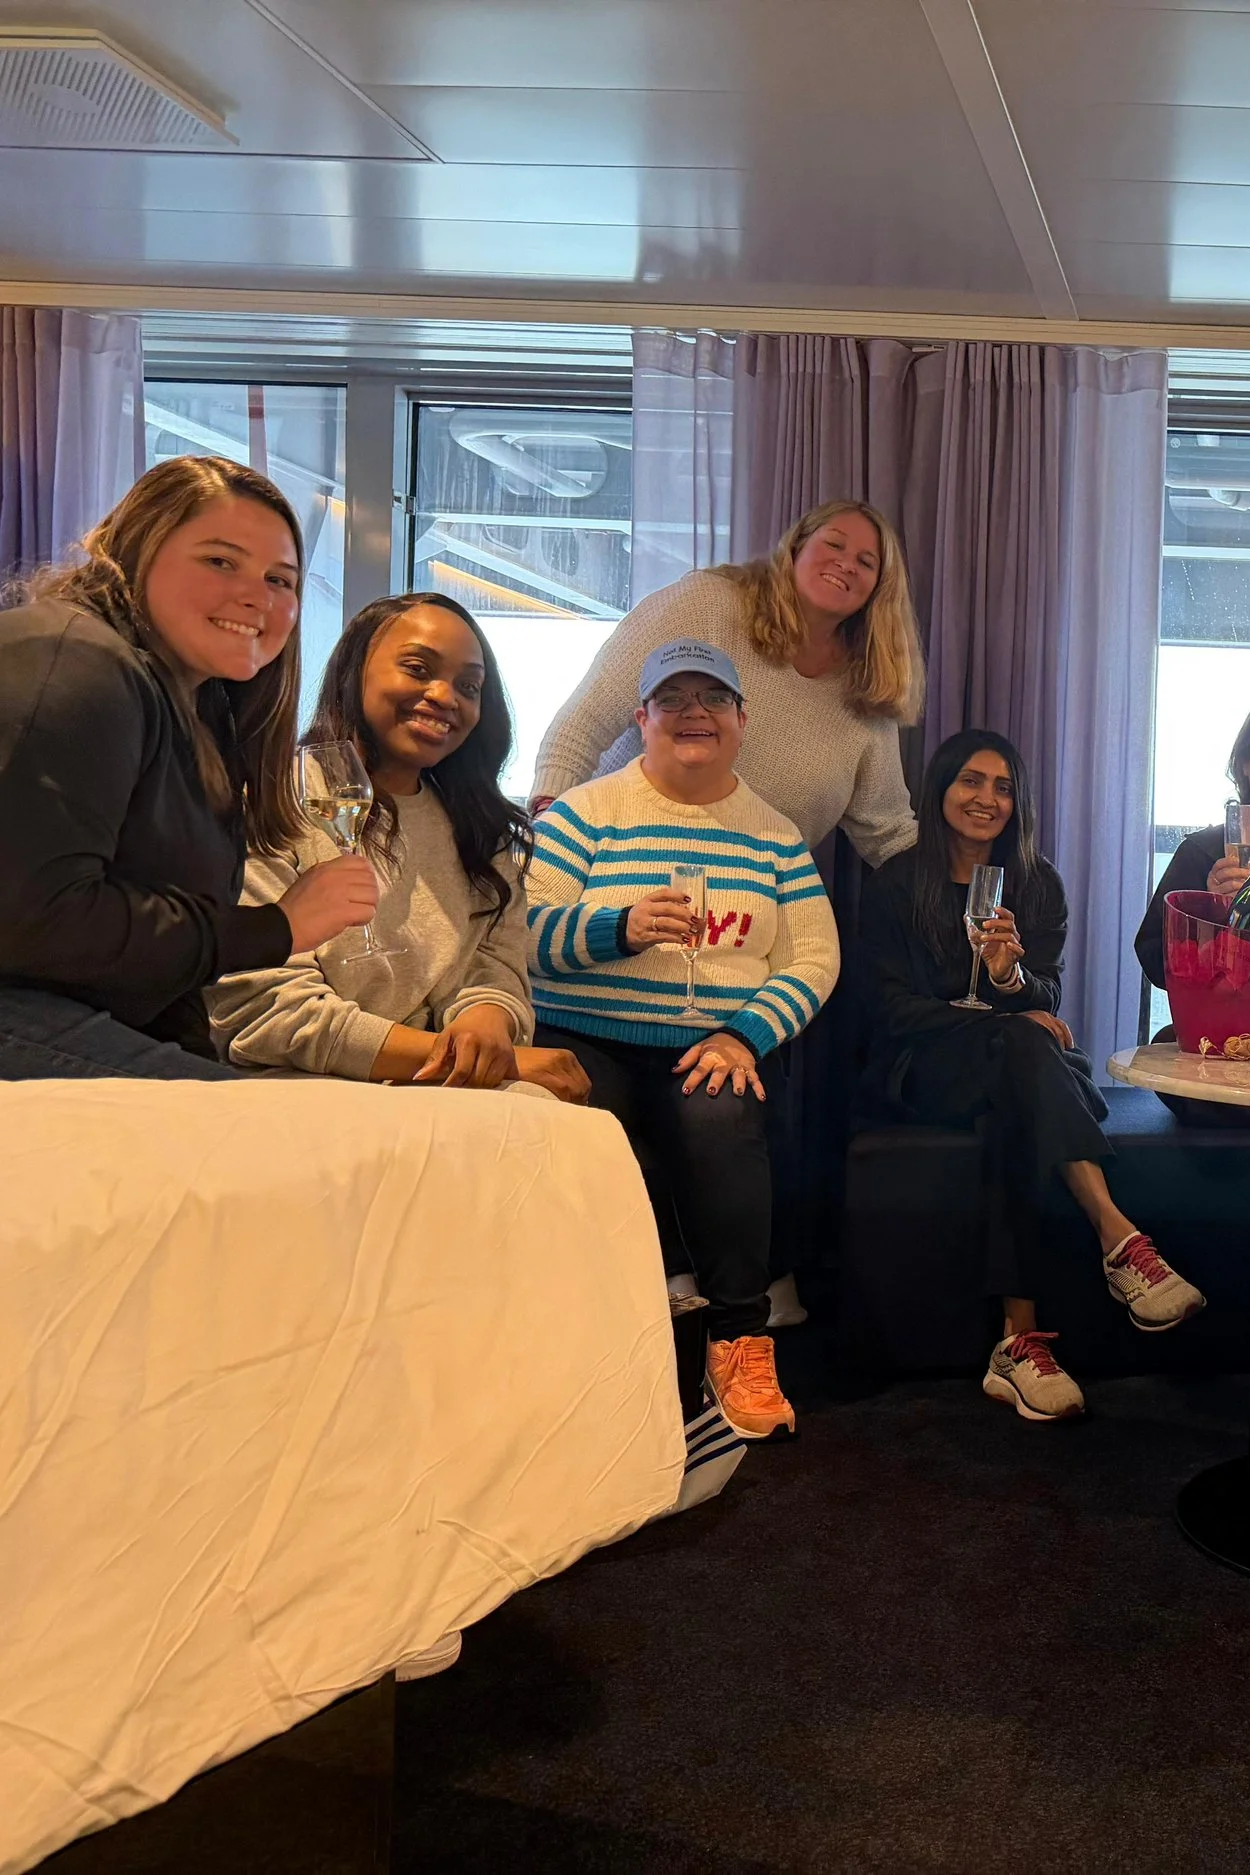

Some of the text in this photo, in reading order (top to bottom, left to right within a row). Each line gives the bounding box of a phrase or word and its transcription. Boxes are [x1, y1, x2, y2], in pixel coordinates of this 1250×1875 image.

[663, 645, 712, 658] Not My First
[660, 652, 715, 665] Embarkation
